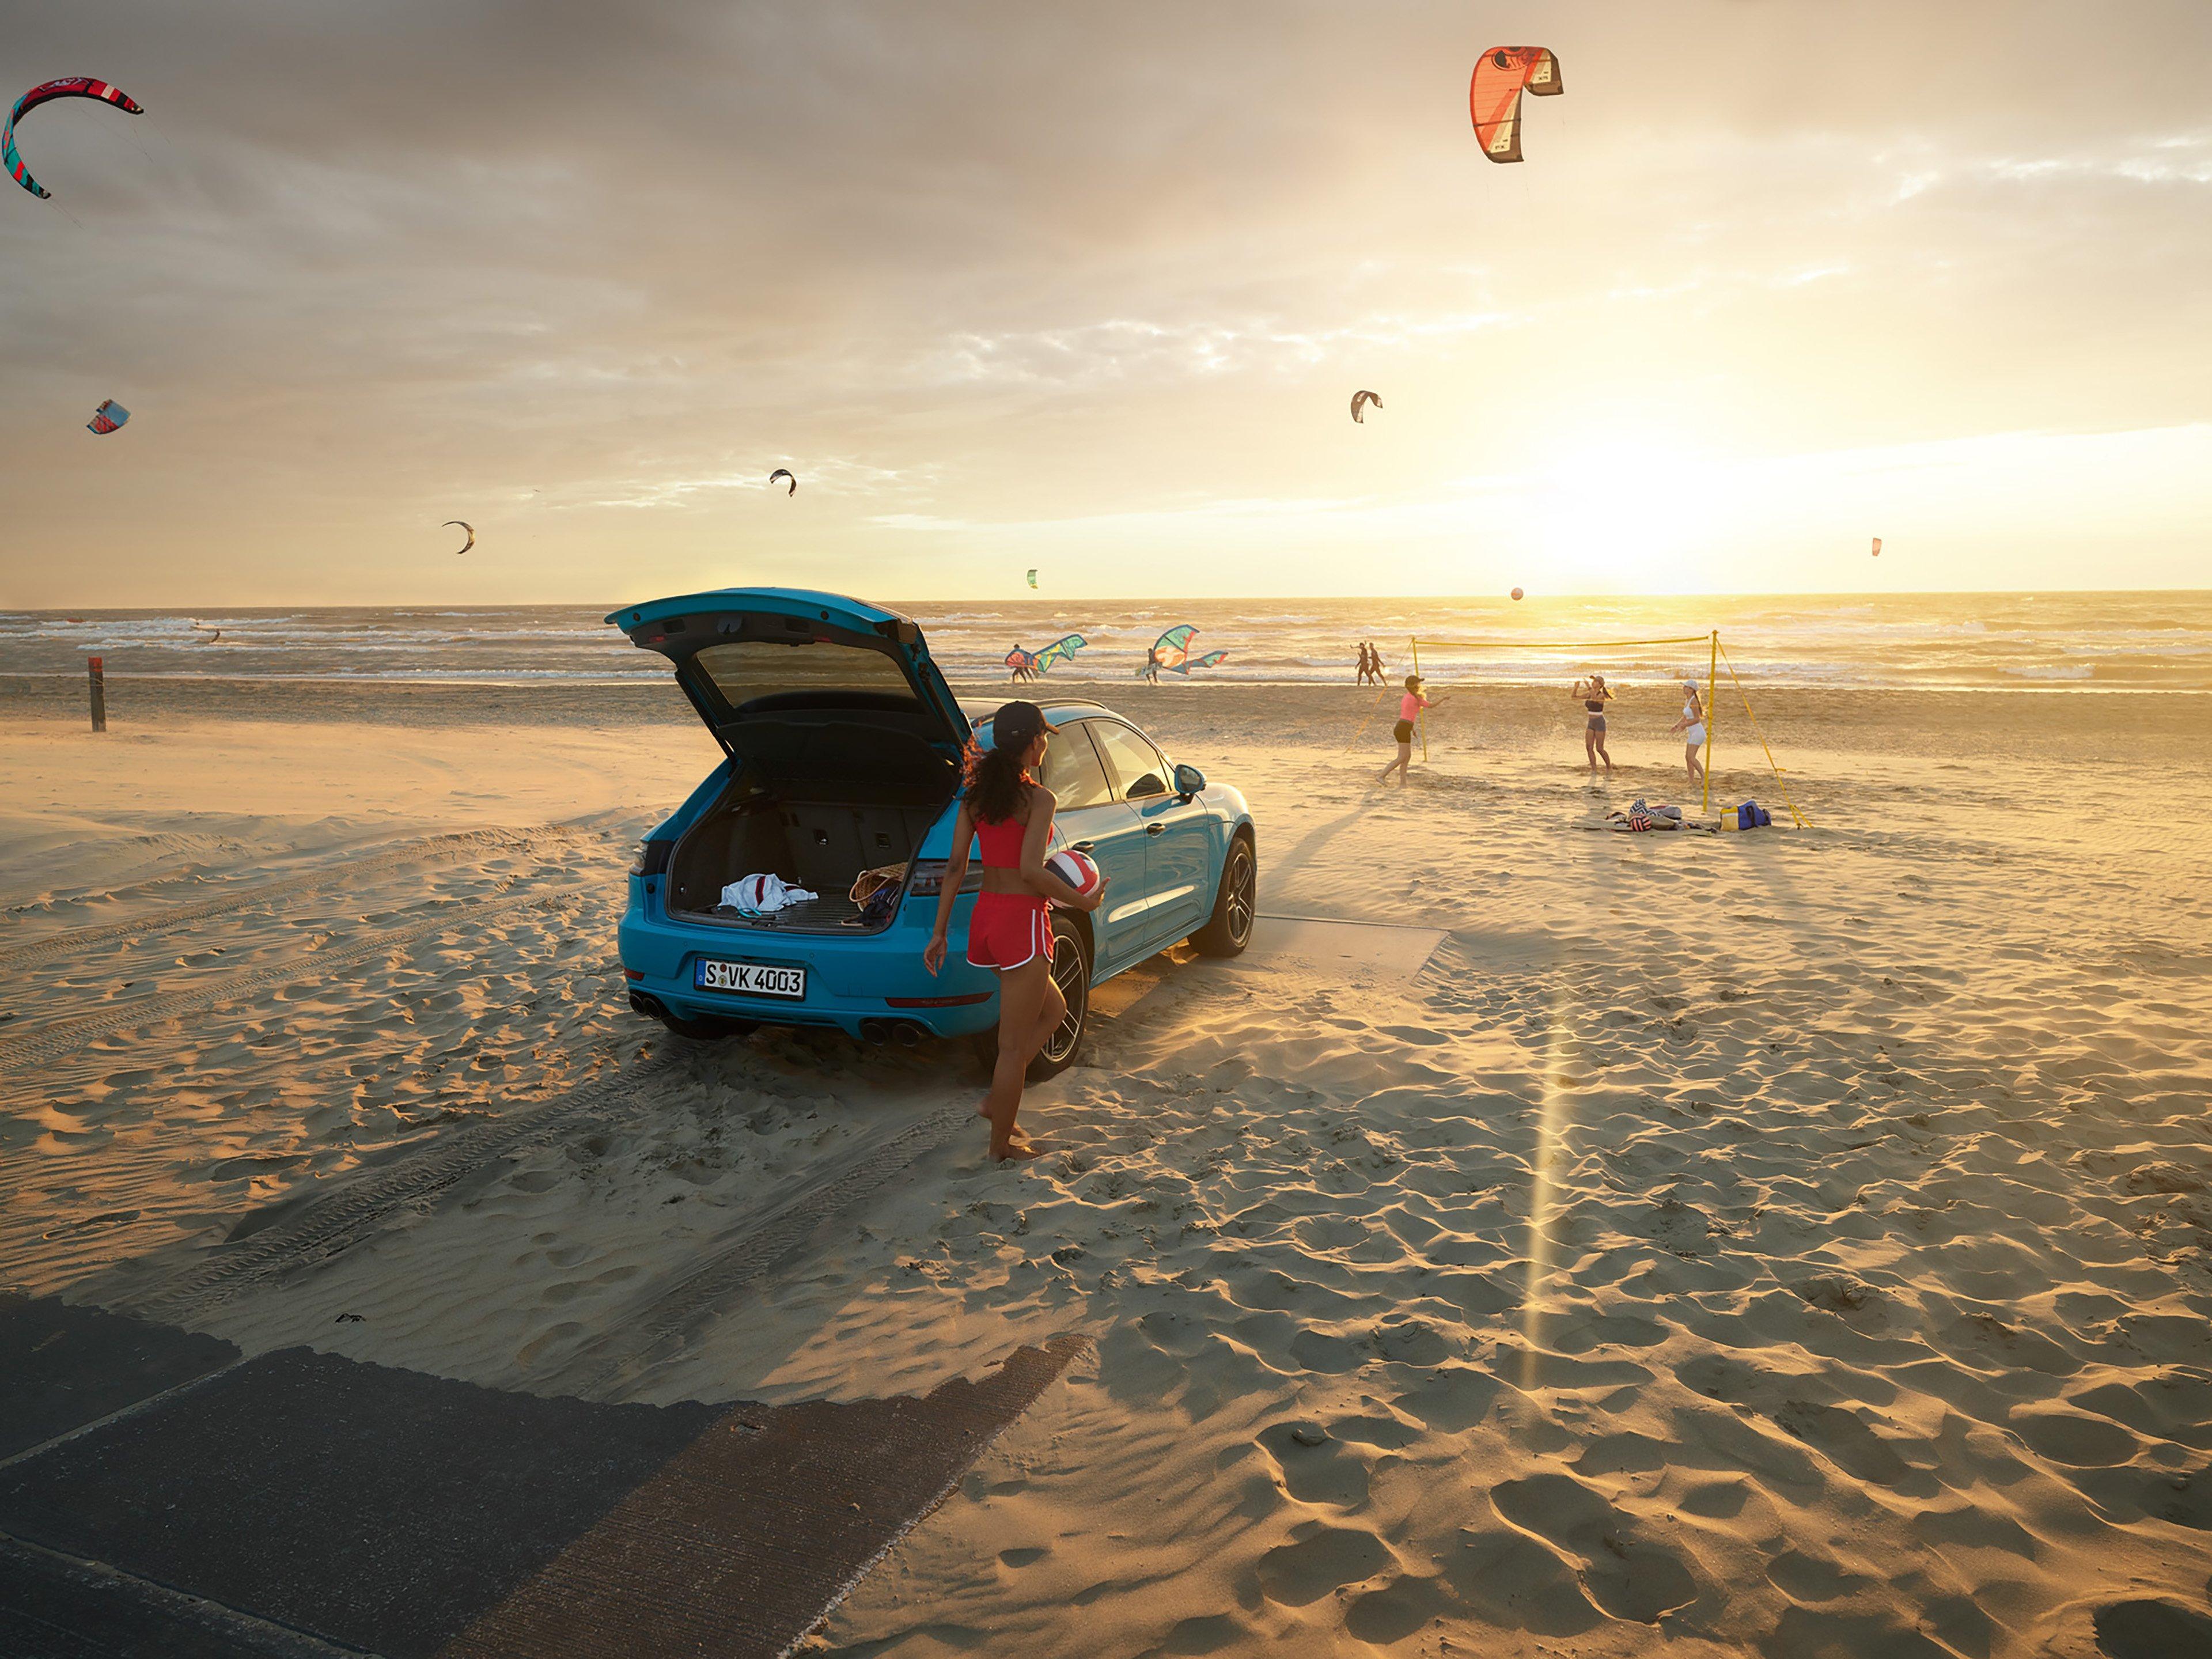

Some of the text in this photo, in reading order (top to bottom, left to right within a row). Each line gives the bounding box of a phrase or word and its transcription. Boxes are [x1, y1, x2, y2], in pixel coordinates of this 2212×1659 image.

[706, 964, 801, 993] S VK 4003
